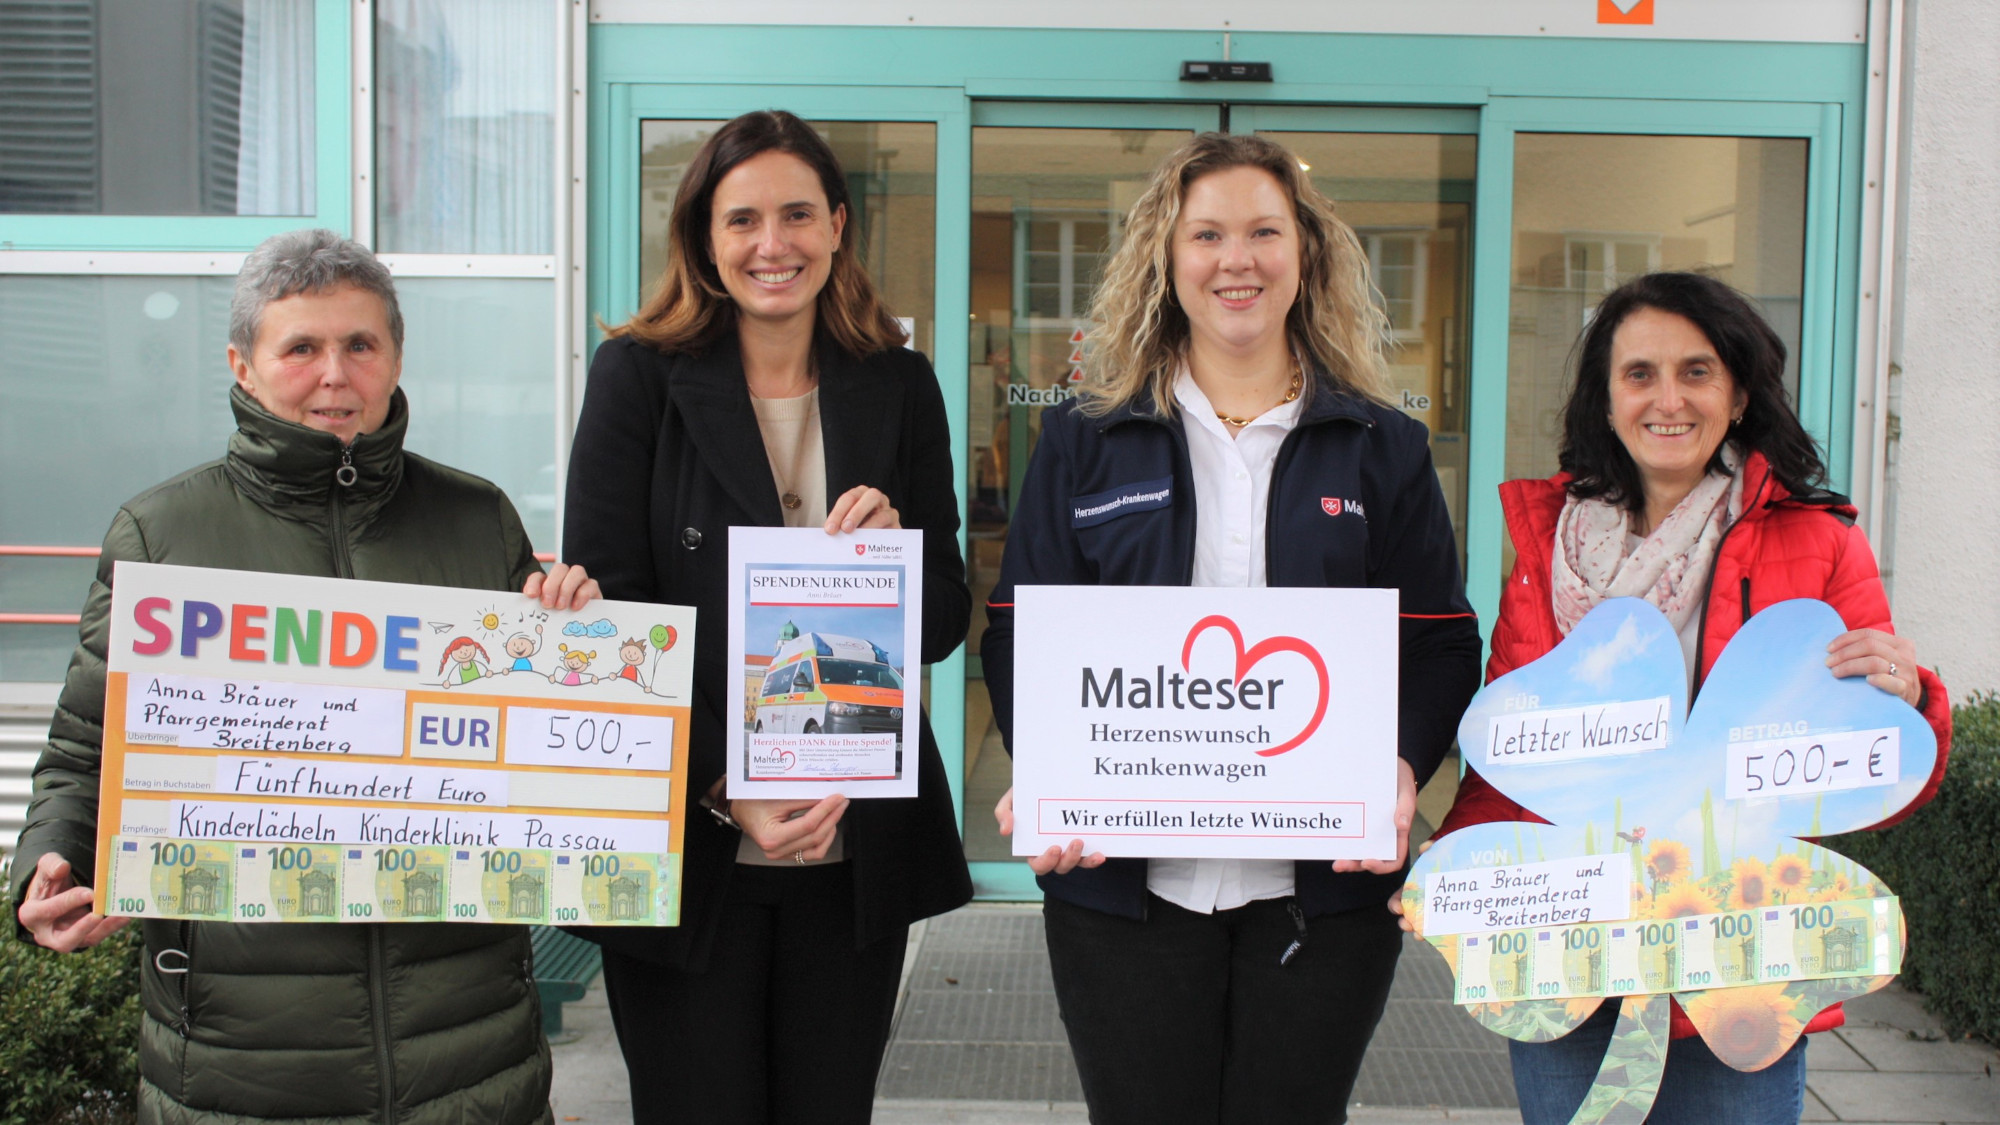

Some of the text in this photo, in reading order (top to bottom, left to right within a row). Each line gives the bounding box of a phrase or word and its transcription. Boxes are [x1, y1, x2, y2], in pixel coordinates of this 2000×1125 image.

[868, 544, 903, 553] Malteser
[753, 576, 896, 589] SPENDENURKUNDE
[132, 596, 420, 672] SPENDE
[147, 678, 359, 713] Anna Bräuer und
[1081, 665, 1283, 711] Malteser
[1504, 693, 1540, 711] FÜR
[144, 703, 329, 732] Pfarrgemeinderat
[1582, 704, 1669, 748] Wunsch
[212, 729, 352, 754] Breitenberg
[419, 715, 490, 747] EUR
[547, 716, 651, 764] 500,-
[1090, 723, 1271, 744] Herzenswunsch
[1729, 720, 1809, 743] BETRAG
[829, 738, 840, 746] für
[842, 738, 858, 746] Ihre
[860, 738, 892, 748] Spende!
[754, 755, 788, 763] Malteser
[1868, 736, 1888, 777] €
[1093, 757, 1267, 783] Krankenwagen
[125, 778, 152, 788] Betrag
[163, 780, 211, 789] Buchstaben
[438, 778, 487, 803] Euro
[122, 825, 167, 835] Empfänger
[178, 803, 618, 851] Kinderlächeln Kinderklinik Passau
[1061, 809, 1342, 829] Wir erfüllen letzte Wünsche
[150, 842, 196, 867] 100
[268, 847, 312, 871] 100
[374, 848, 416, 872] 100
[480, 850, 522, 873] 100
[580, 855, 620, 877] 100
[1471, 850, 1507, 865] VON
[1435, 861, 1604, 893] Anna Bräuer und
[119, 898, 145, 913] 100
[1433, 882, 1589, 914] Pfarrgemeinderat
[239, 903, 266, 917] 100
[347, 903, 372, 917] 100
[453, 904, 477, 917] 100
[555, 908, 578, 921] 100
[1485, 905, 1591, 927] Breitenberg
[1789, 905, 1834, 930] 100
[1635, 922, 1676, 947] 100
[1709, 913, 1753, 938] 100
[1487, 932, 1527, 955] 100
[1560, 927, 1600, 950] 100
[1686, 971, 1711, 985] 100
[1765, 962, 1790, 978] 100
[1465, 985, 1486, 999] 100
[1496, 979, 1513, 987] EURO
[1537, 981, 1559, 996] 100
[1611, 978, 1635, 993] 100
